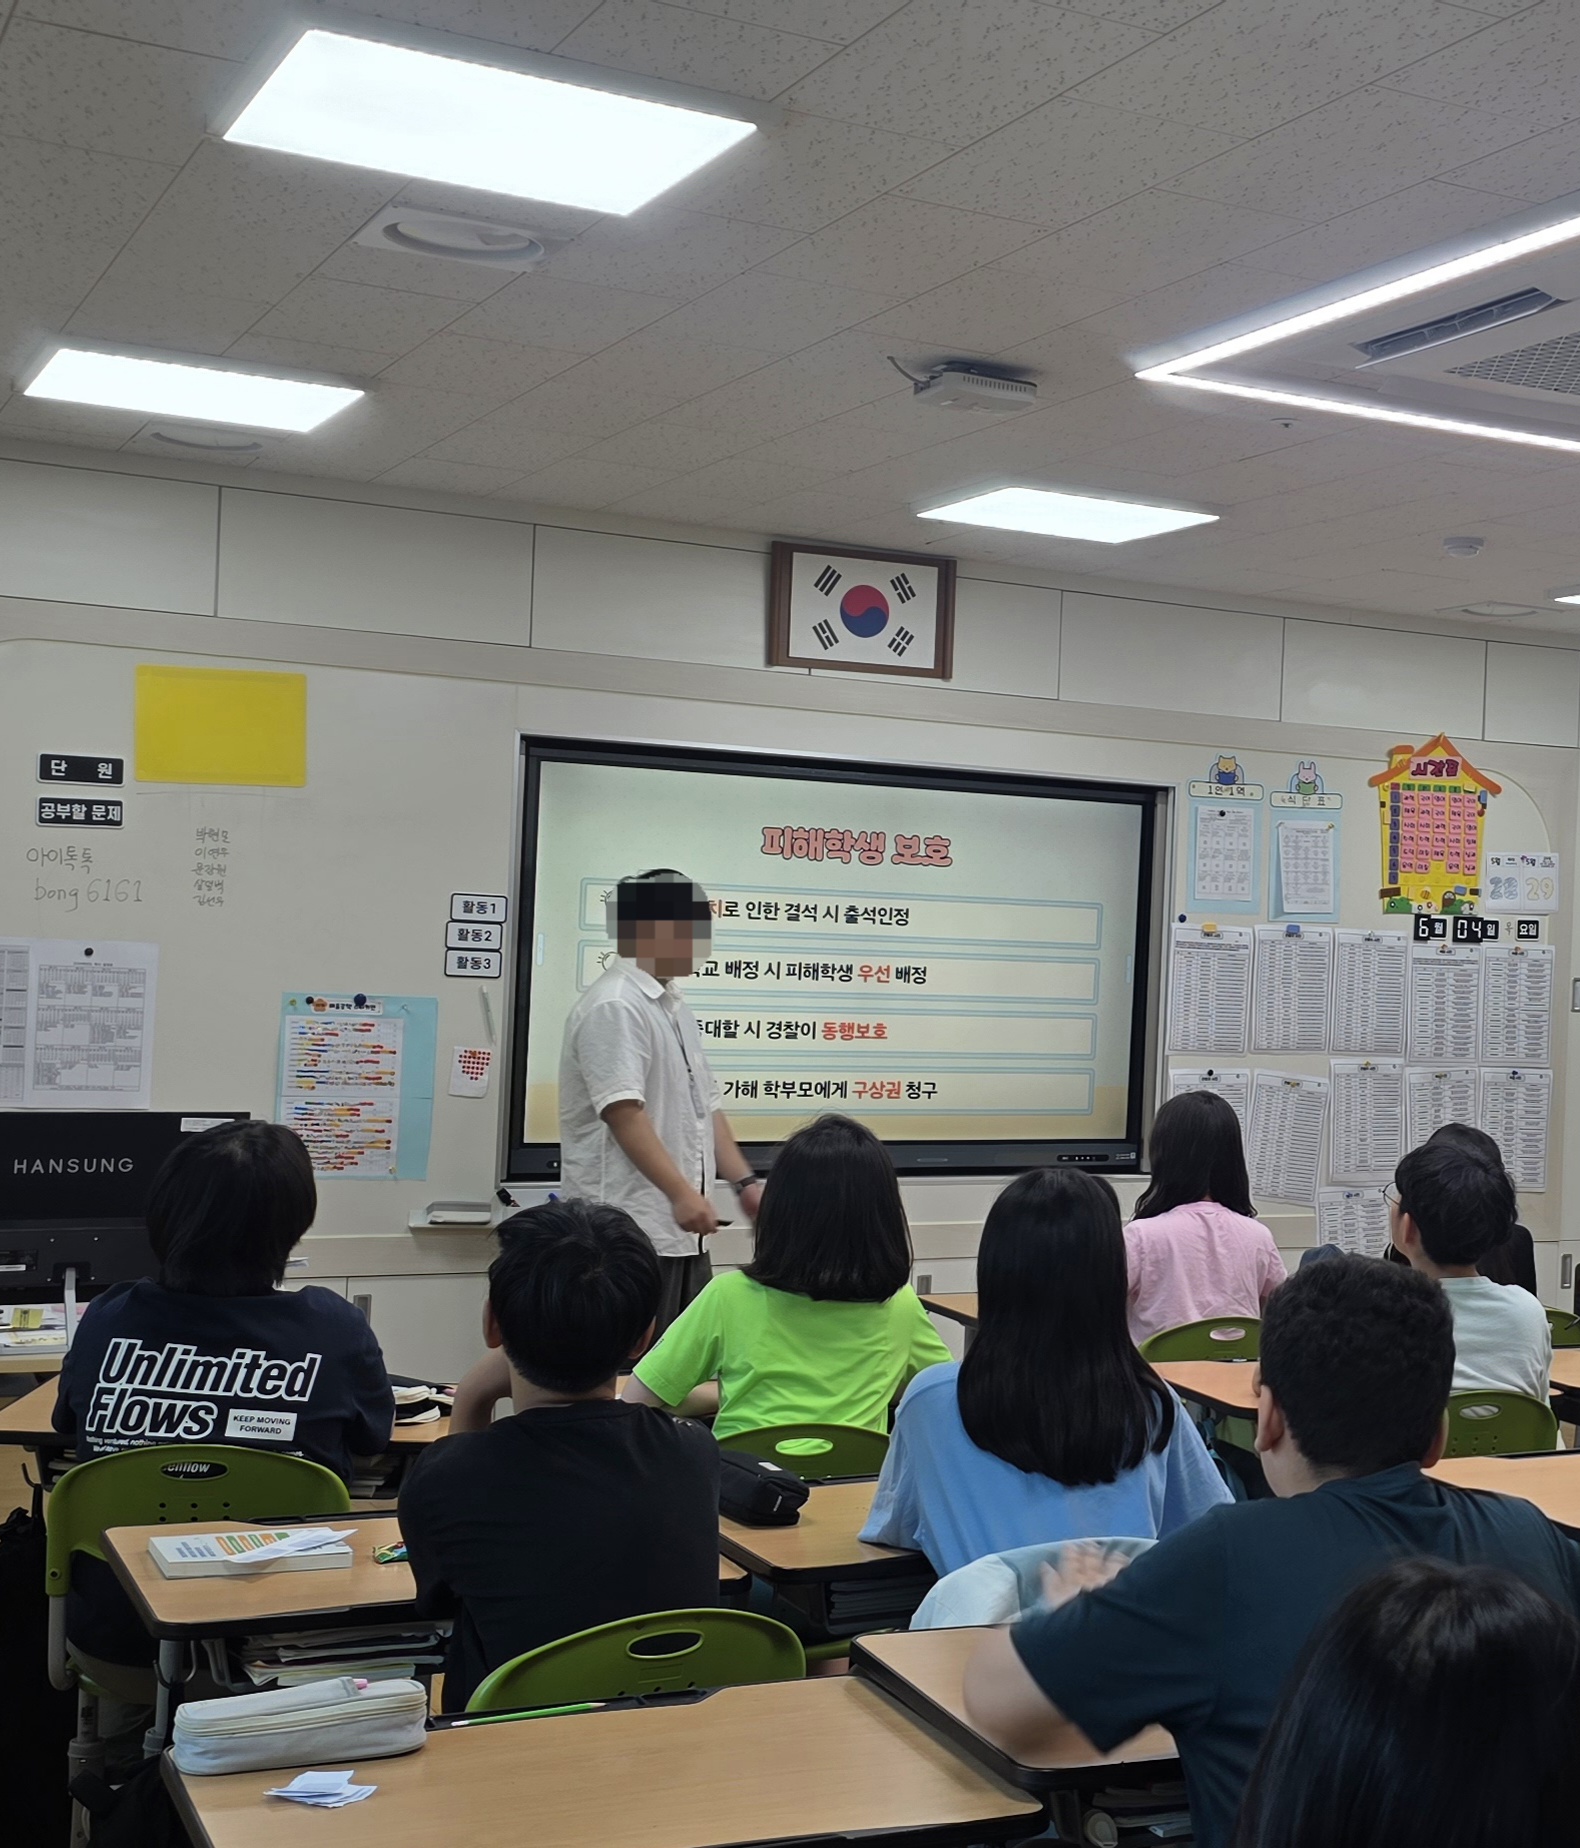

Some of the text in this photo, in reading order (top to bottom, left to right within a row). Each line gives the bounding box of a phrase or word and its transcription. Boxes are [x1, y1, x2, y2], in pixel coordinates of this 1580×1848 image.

[40, 802, 122, 822] 공부할 문제
[760, 826, 953, 867] 피해학생 보호
[26, 845, 94, 874] 아이톡톡
[34, 878, 143, 913] bong 6161
[1525, 876, 1555, 901] 29
[462, 900, 497, 915] 활동1
[746, 900, 780, 921] 인한
[784, 903, 818, 922] 결석
[822, 904, 839, 922] 시
[844, 905, 910, 926] 출석인정
[457, 928, 493, 942] 활동2
[1419, 917, 1429, 938] 6
[1457, 919, 1482, 939] 04
[1519, 923, 1537, 936] 요일
[456, 955, 492, 970] 활동3
[725, 960, 759, 979] 배정
[764, 961, 781, 980] 시
[785, 962, 854, 983] 피해학생
[857, 964, 891, 983] 우선
[895, 965, 928, 985] 배정
[743, 1020, 761, 1039] 시
[766, 1021, 817, 1040] 경찰이
[821, 1022, 888, 1041] 동행보호
[723, 1080, 938, 1100] 가해 학부모에게 구상권 청구
[13, 1157, 135, 1175] HANSUNG
[100, 1337, 322, 1402] Unlimited
[85, 1383, 219, 1440] Flows
[233, 1414, 291, 1427] KEEP MOVING
[239, 1424, 283, 1436] FORWARD
